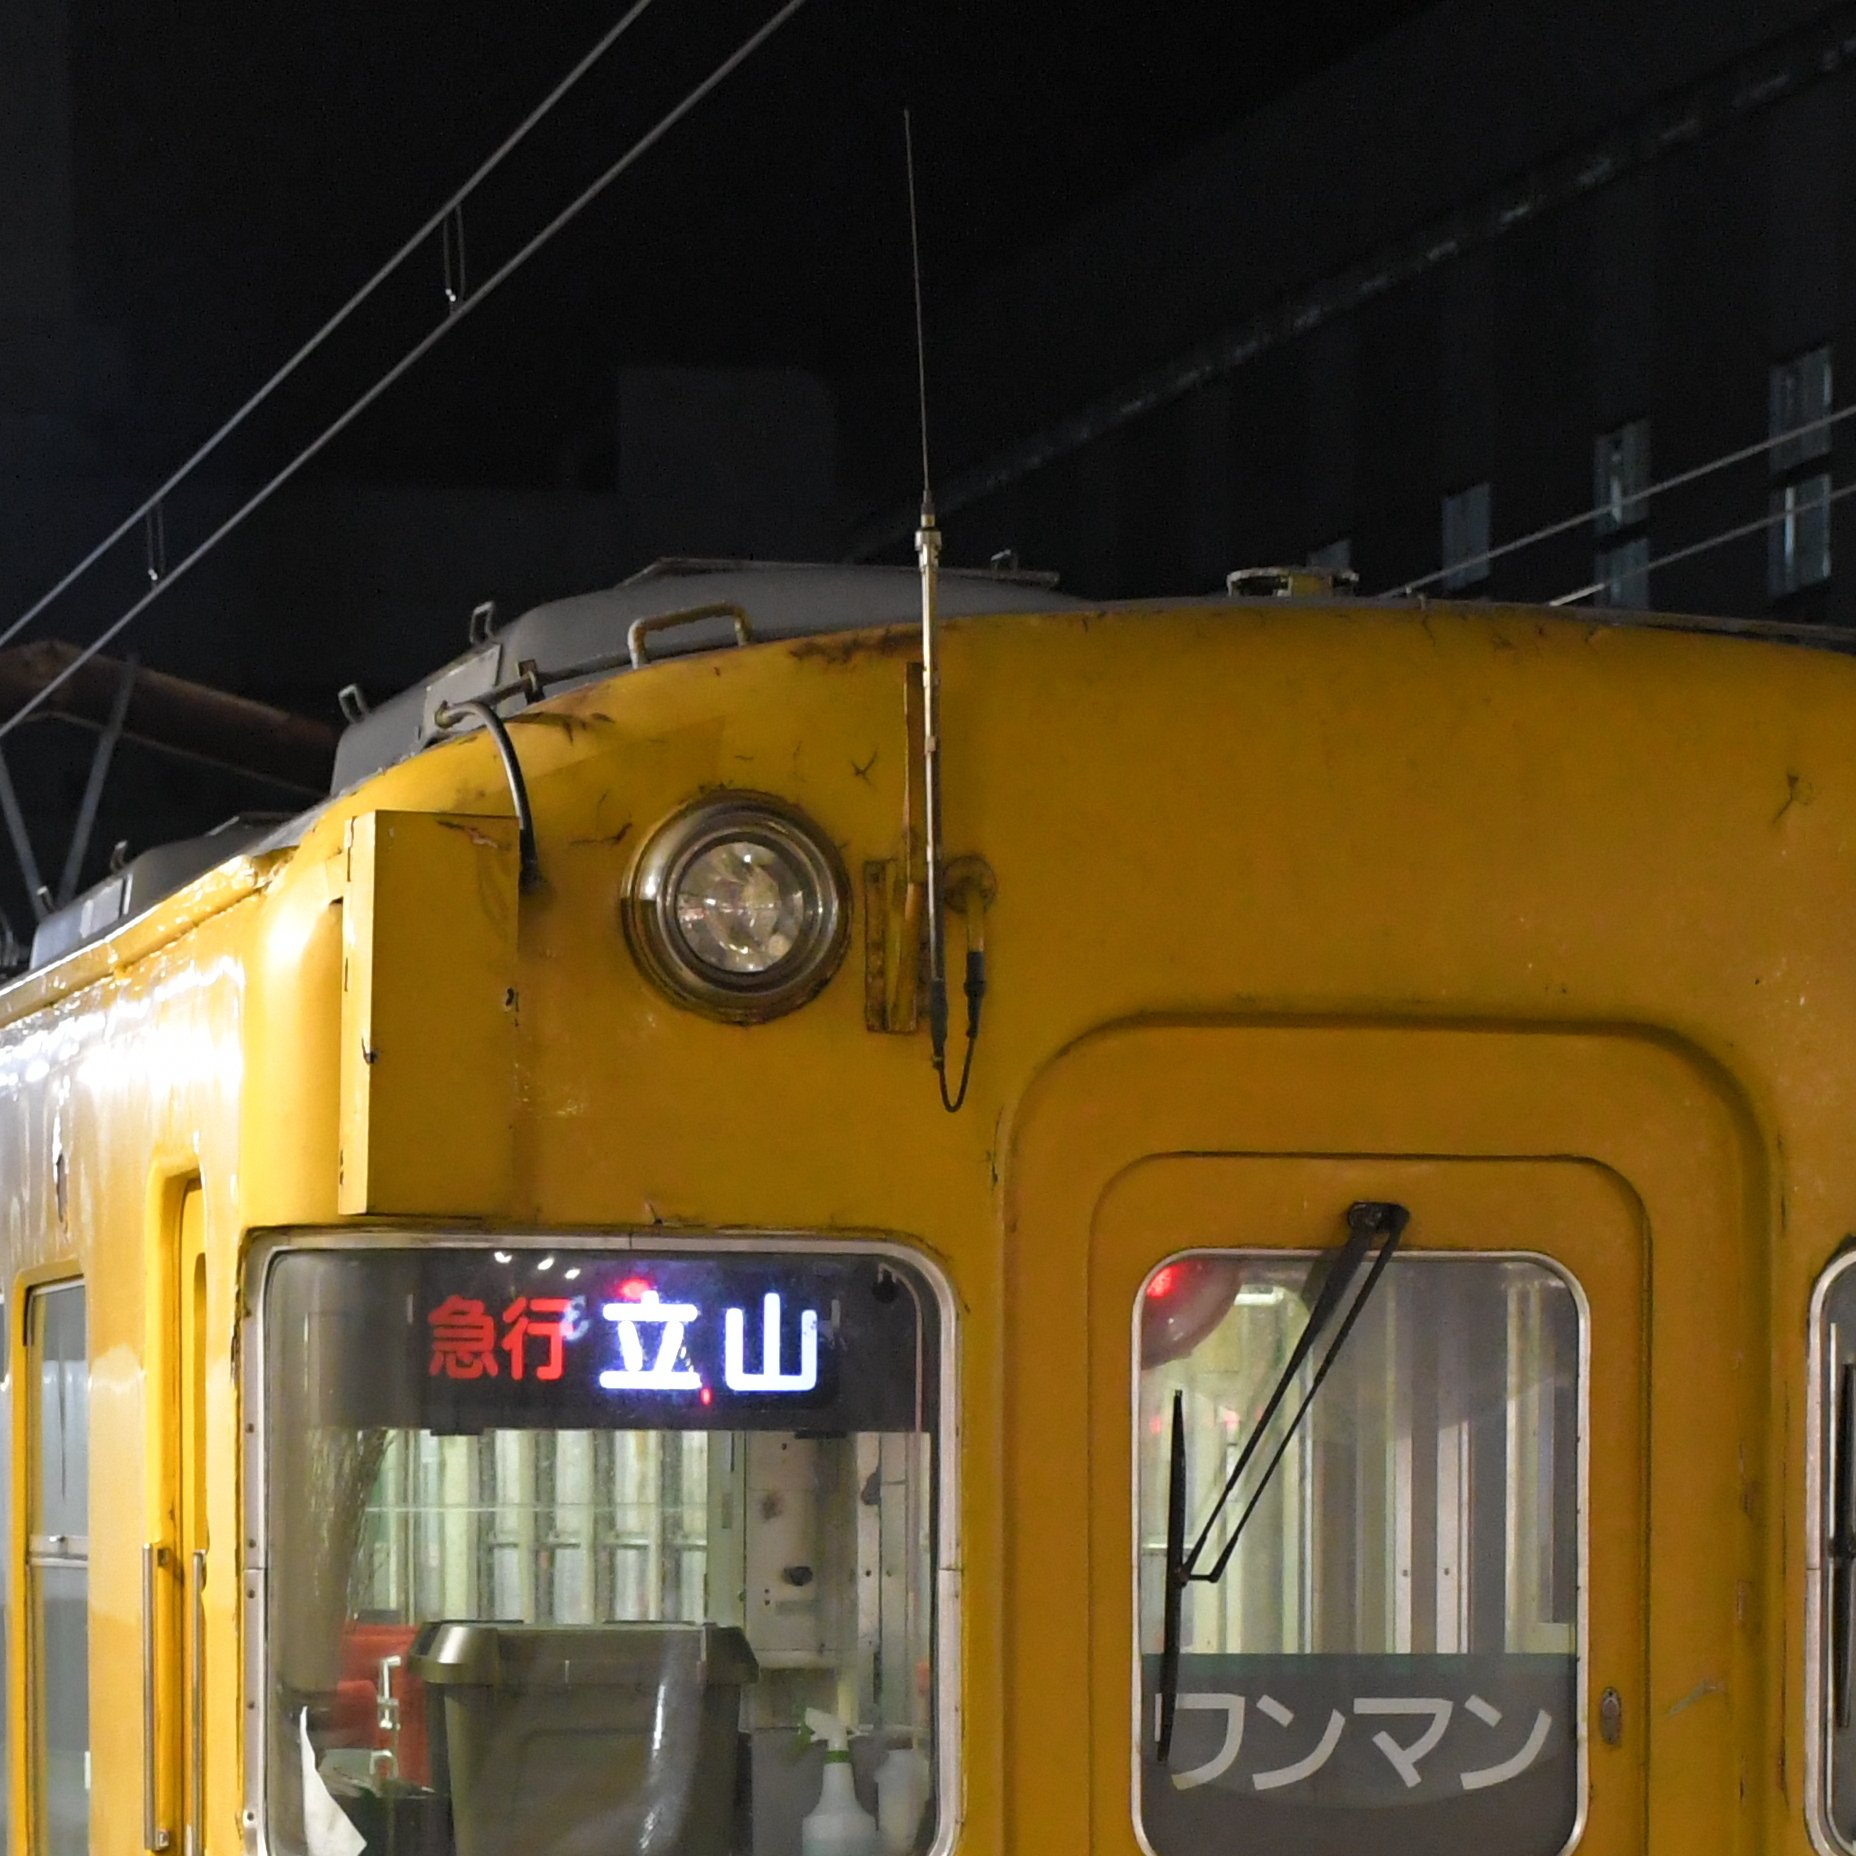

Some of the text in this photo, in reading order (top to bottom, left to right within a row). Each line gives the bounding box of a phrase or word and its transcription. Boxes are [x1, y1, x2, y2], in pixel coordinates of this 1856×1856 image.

[428, 1290, 817, 1391] 急行 立山
[1155, 1693, 1552, 1791] ワンマン
